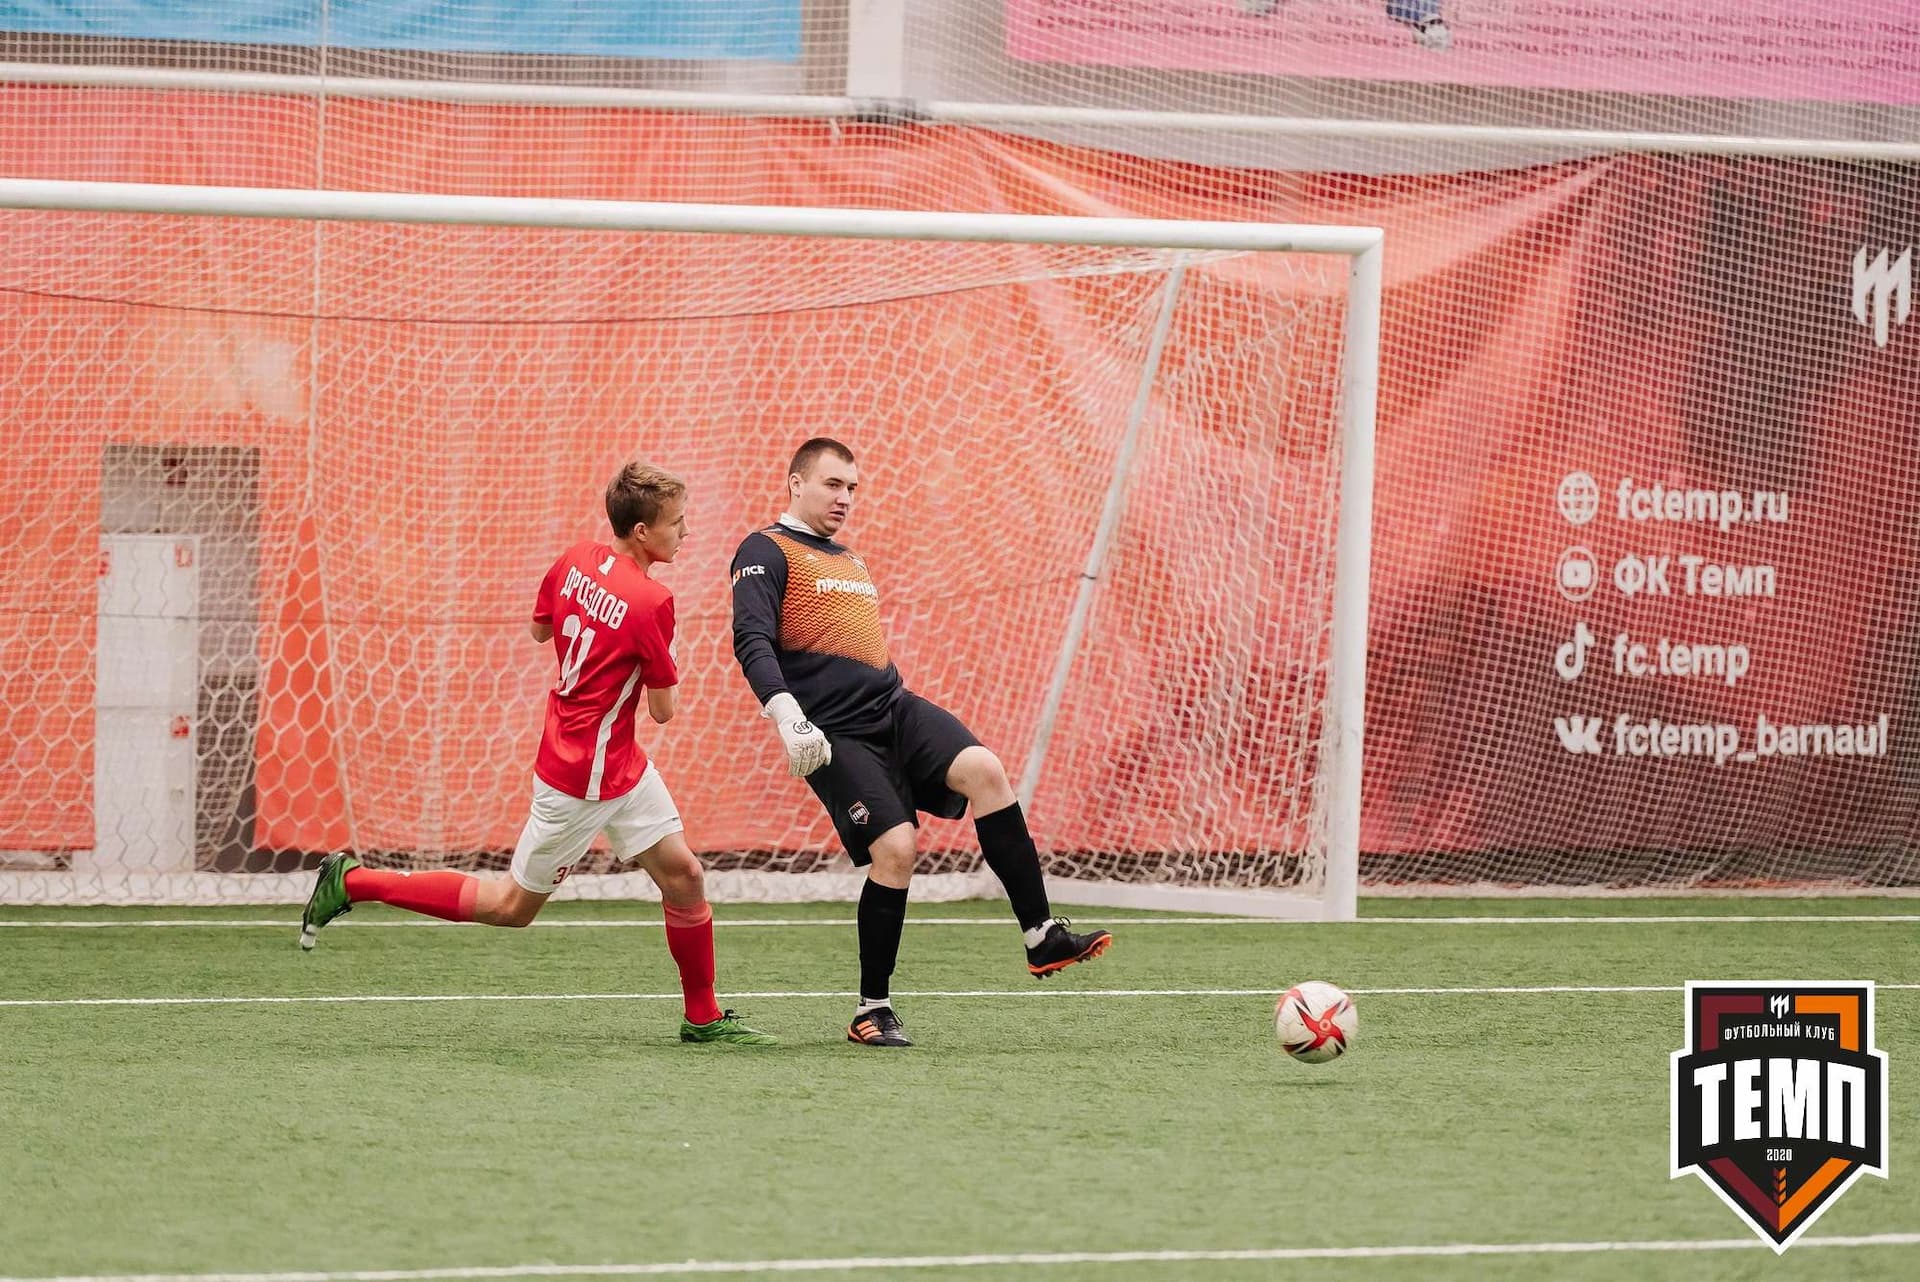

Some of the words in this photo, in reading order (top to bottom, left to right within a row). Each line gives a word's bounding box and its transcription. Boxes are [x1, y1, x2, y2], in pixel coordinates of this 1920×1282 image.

[1616, 477, 1789, 532] fctemp.ru
[560, 565, 629, 630] ДРОЗДОВ
[1613, 553, 1671, 596] ФК
[1679, 555, 1776, 598] Темп
[1613, 633, 1750, 687] fc.temp
[1613, 713, 1889, 766] fctemp_barnaul
